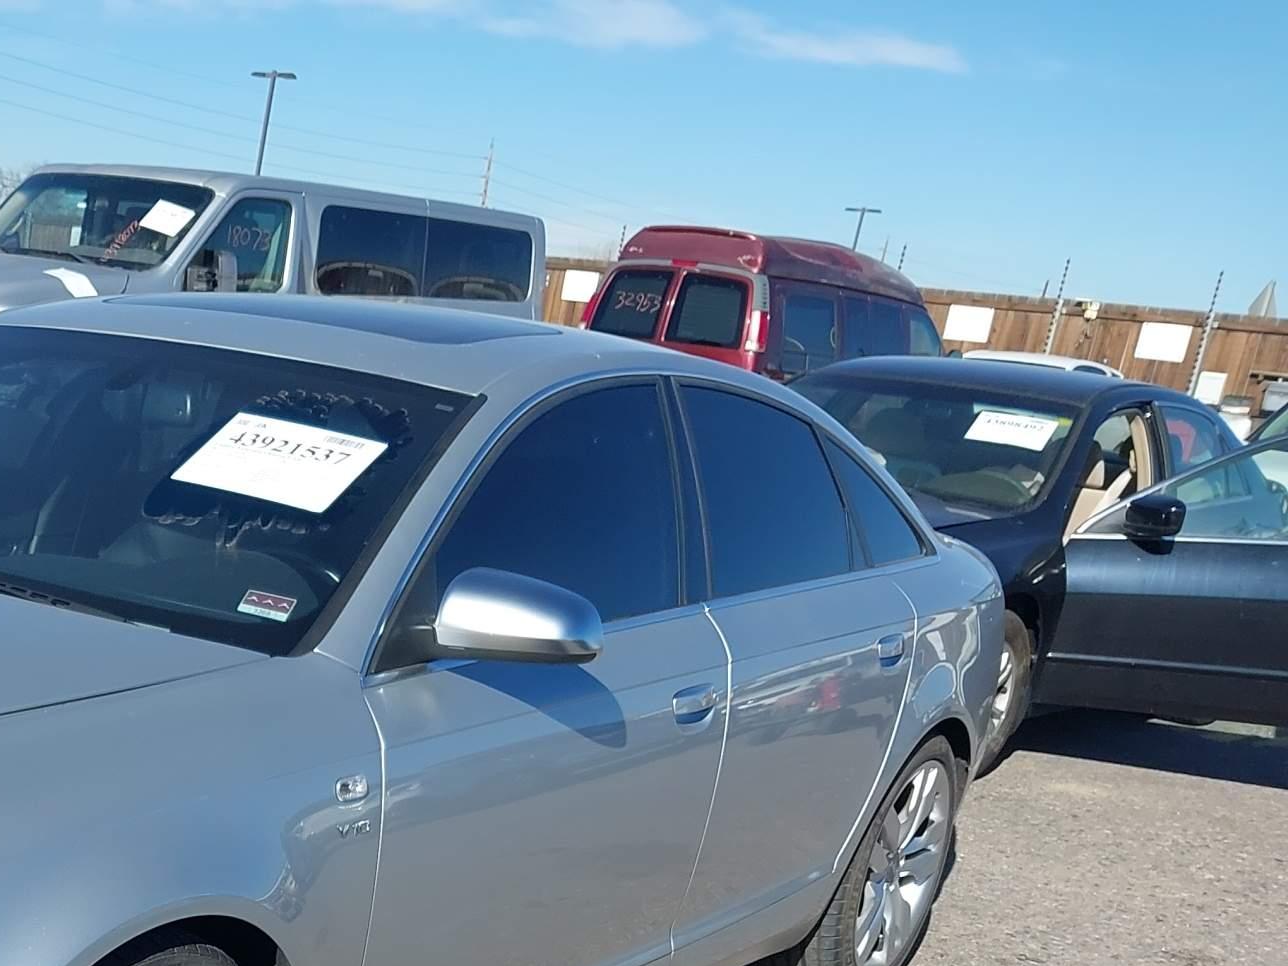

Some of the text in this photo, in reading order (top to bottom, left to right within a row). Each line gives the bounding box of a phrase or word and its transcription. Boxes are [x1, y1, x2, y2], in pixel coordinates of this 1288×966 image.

[226, 224, 271, 250] 18073
[615, 290, 662, 313] 32953
[229, 431, 352, 465] 43921537
